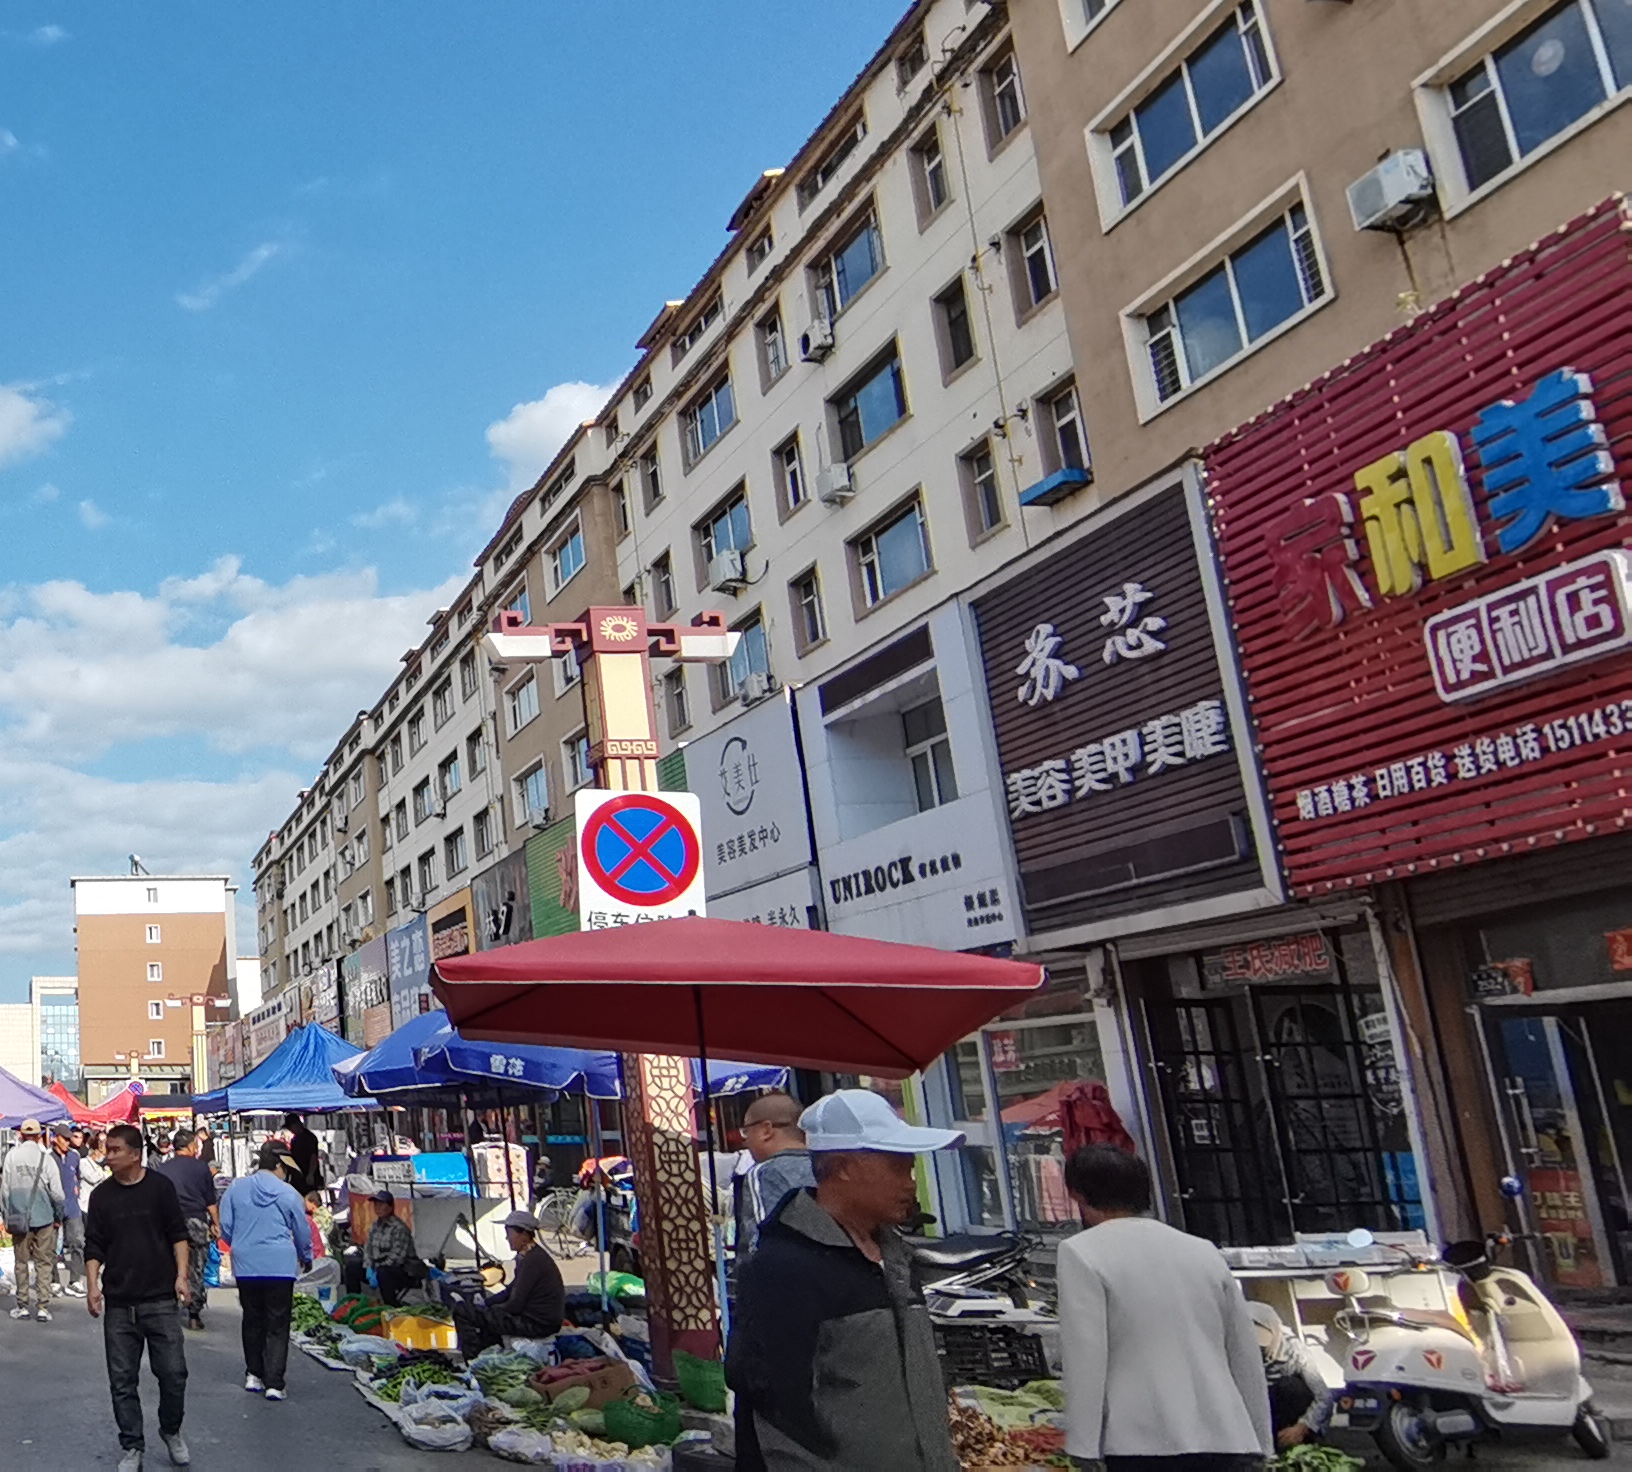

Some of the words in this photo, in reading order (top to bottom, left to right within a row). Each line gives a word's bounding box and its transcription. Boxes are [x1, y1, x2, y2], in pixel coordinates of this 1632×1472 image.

[1436, 573, 1616, 686] 便利店
[1006, 699, 1230, 820] 美容美甲美睫
[1295, 774, 1370, 821] 烟酒糖茶
[1373, 751, 1448, 800] 日用百货
[1453, 722, 1541, 780] 送货电话
[716, 820, 781, 866] 美容美发中心
[829, 855, 916, 905] UNIROCK
[1222, 934, 1330, 981] 王氏减肥
